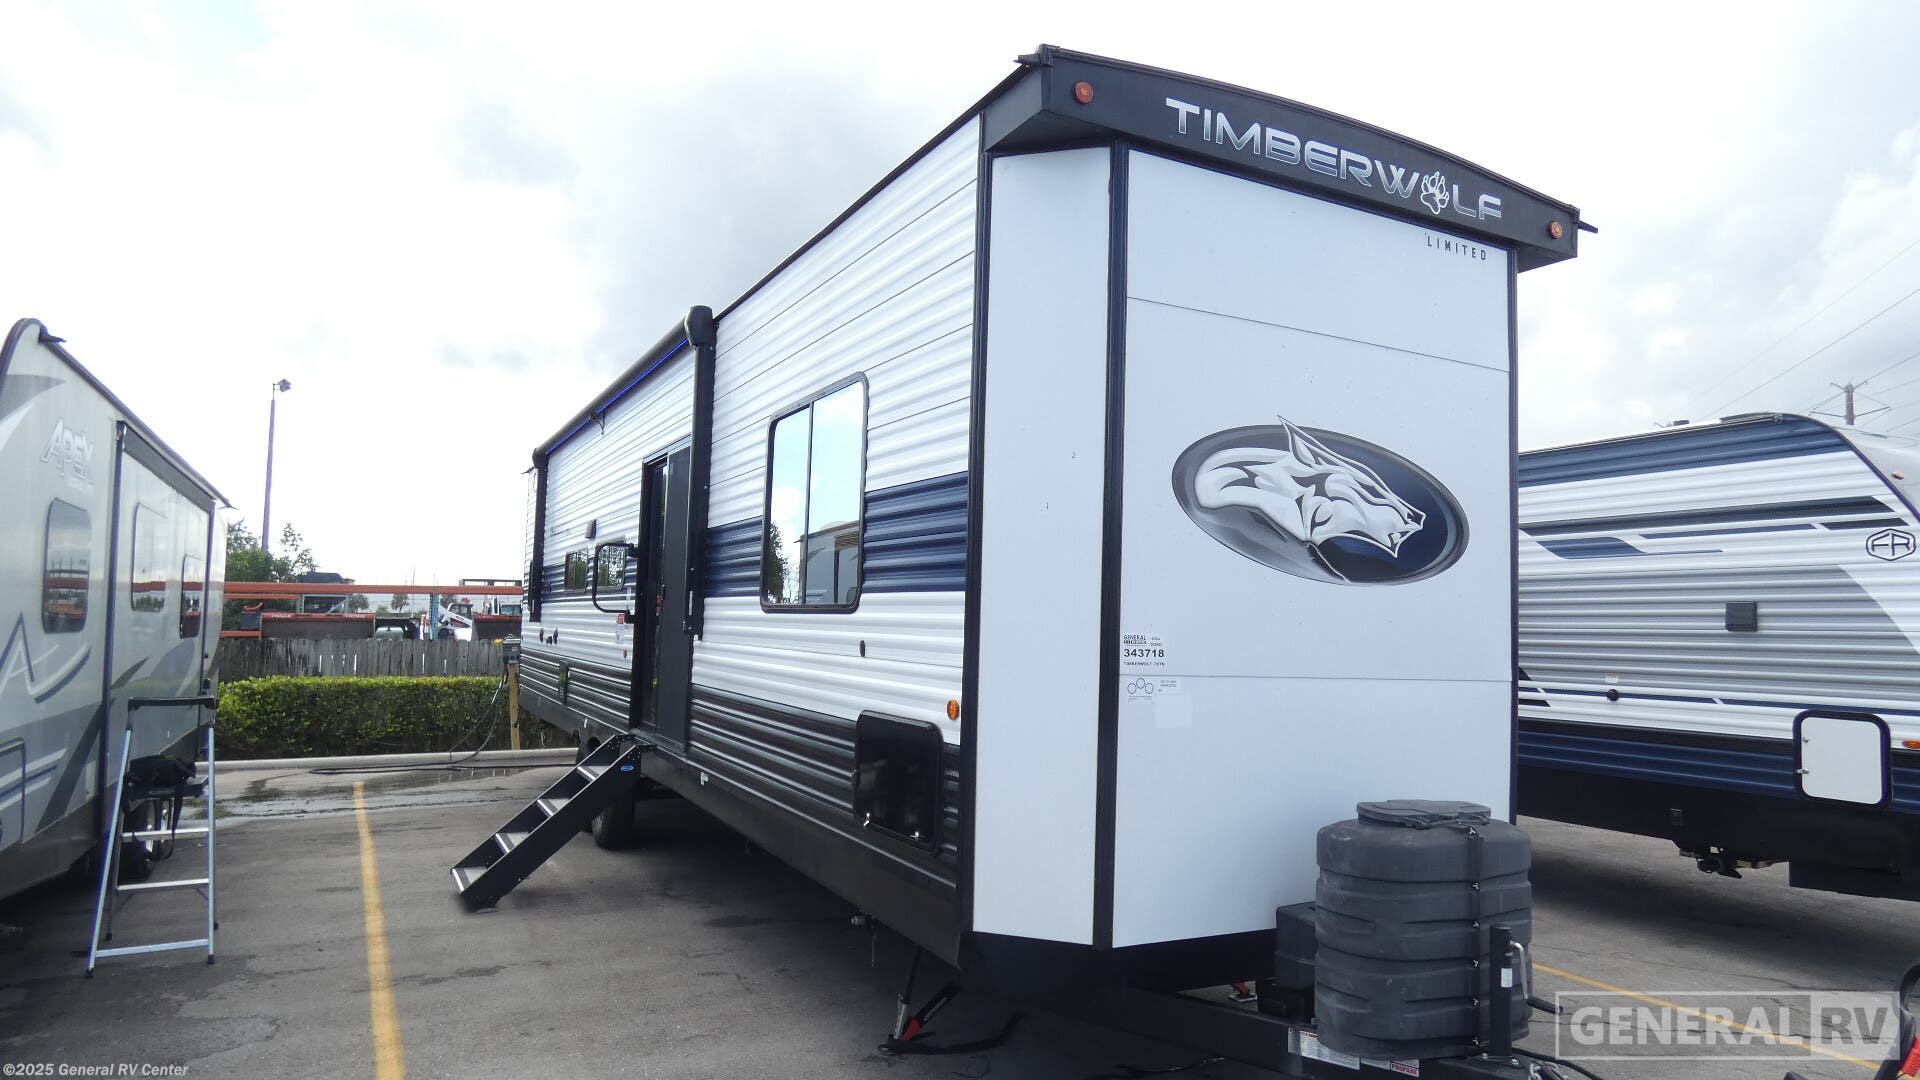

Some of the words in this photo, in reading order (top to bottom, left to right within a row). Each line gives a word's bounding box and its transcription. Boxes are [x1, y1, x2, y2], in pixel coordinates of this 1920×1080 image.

[1426, 235, 1488, 262] LIMITED
[40, 416, 95, 480] APEX
[1123, 649, 1164, 658] 343718
[1391, 1061, 1418, 1076] PROPANE
